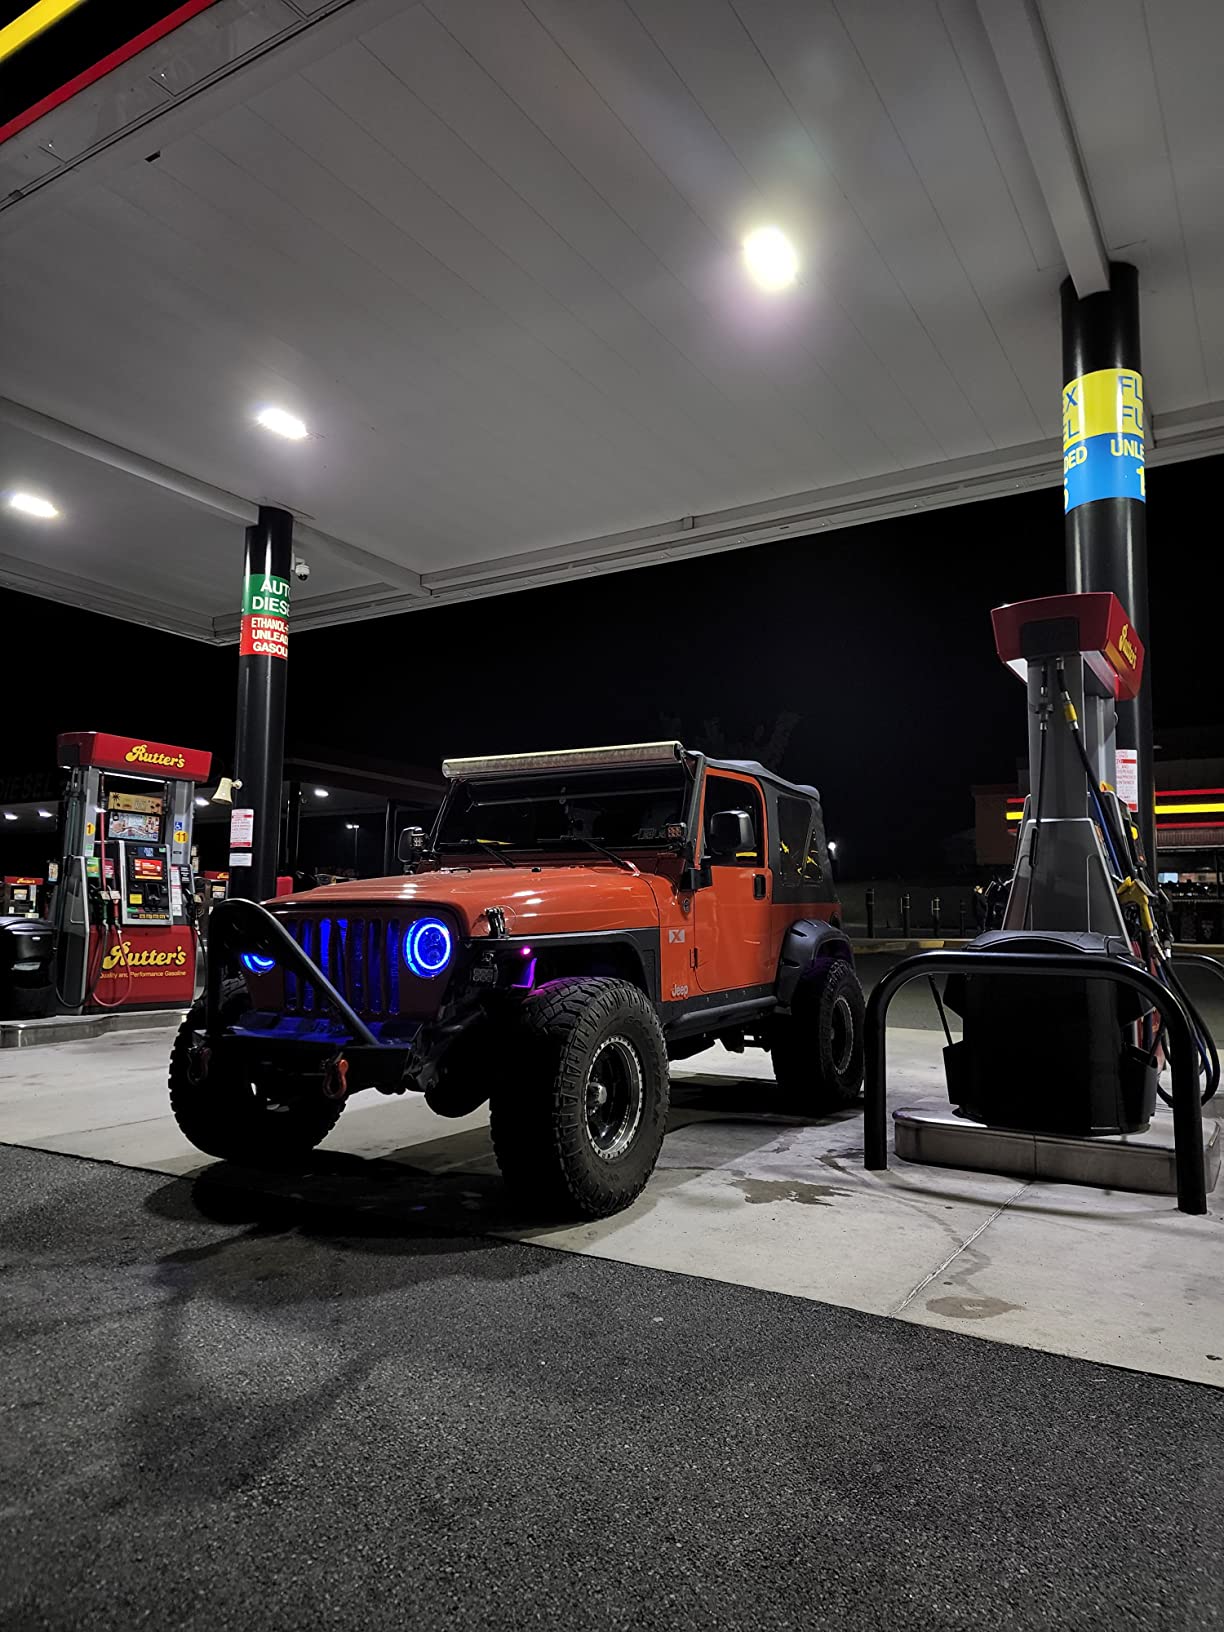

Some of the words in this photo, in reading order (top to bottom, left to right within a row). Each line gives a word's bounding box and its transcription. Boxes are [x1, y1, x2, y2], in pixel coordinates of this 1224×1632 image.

[260, 580, 291, 599] AUT
[252, 596, 290, 617] DIES
[125, 744, 185, 768] Rutter's
[176, 832, 187, 842] 11
[102, 941, 187, 970] Rutter's
[671, 983, 688, 999] Jeep
